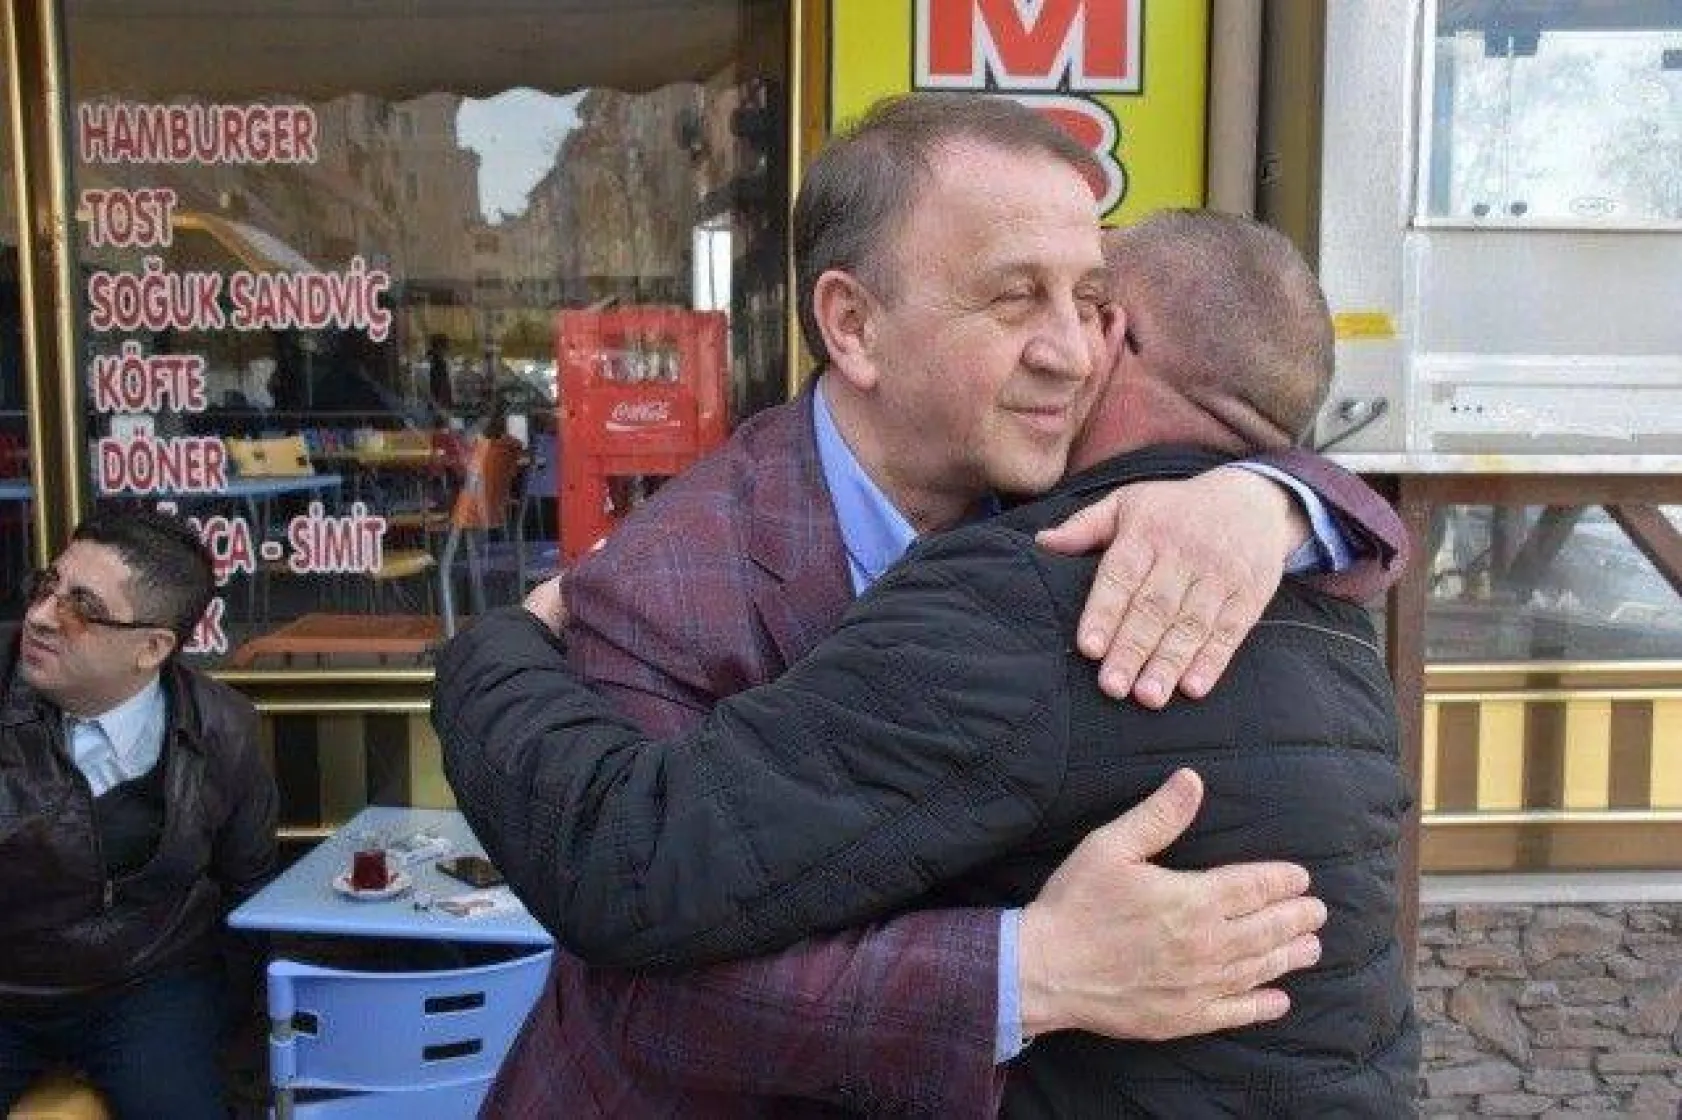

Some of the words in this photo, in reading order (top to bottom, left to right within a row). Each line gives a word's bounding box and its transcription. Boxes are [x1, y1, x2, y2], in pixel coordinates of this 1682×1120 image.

[914, 0, 1143, 94] M
[80, 104, 318, 164] HAMBURGER
[81, 189, 175, 247] TOST
[88, 255, 225, 331] SOĞUK
[230, 254, 391, 342] SANDVİÇ
[95, 341, 207, 413] KÖFTE
[100, 422, 227, 493] DÖNER
[288, 501, 386, 574] SİMİT
